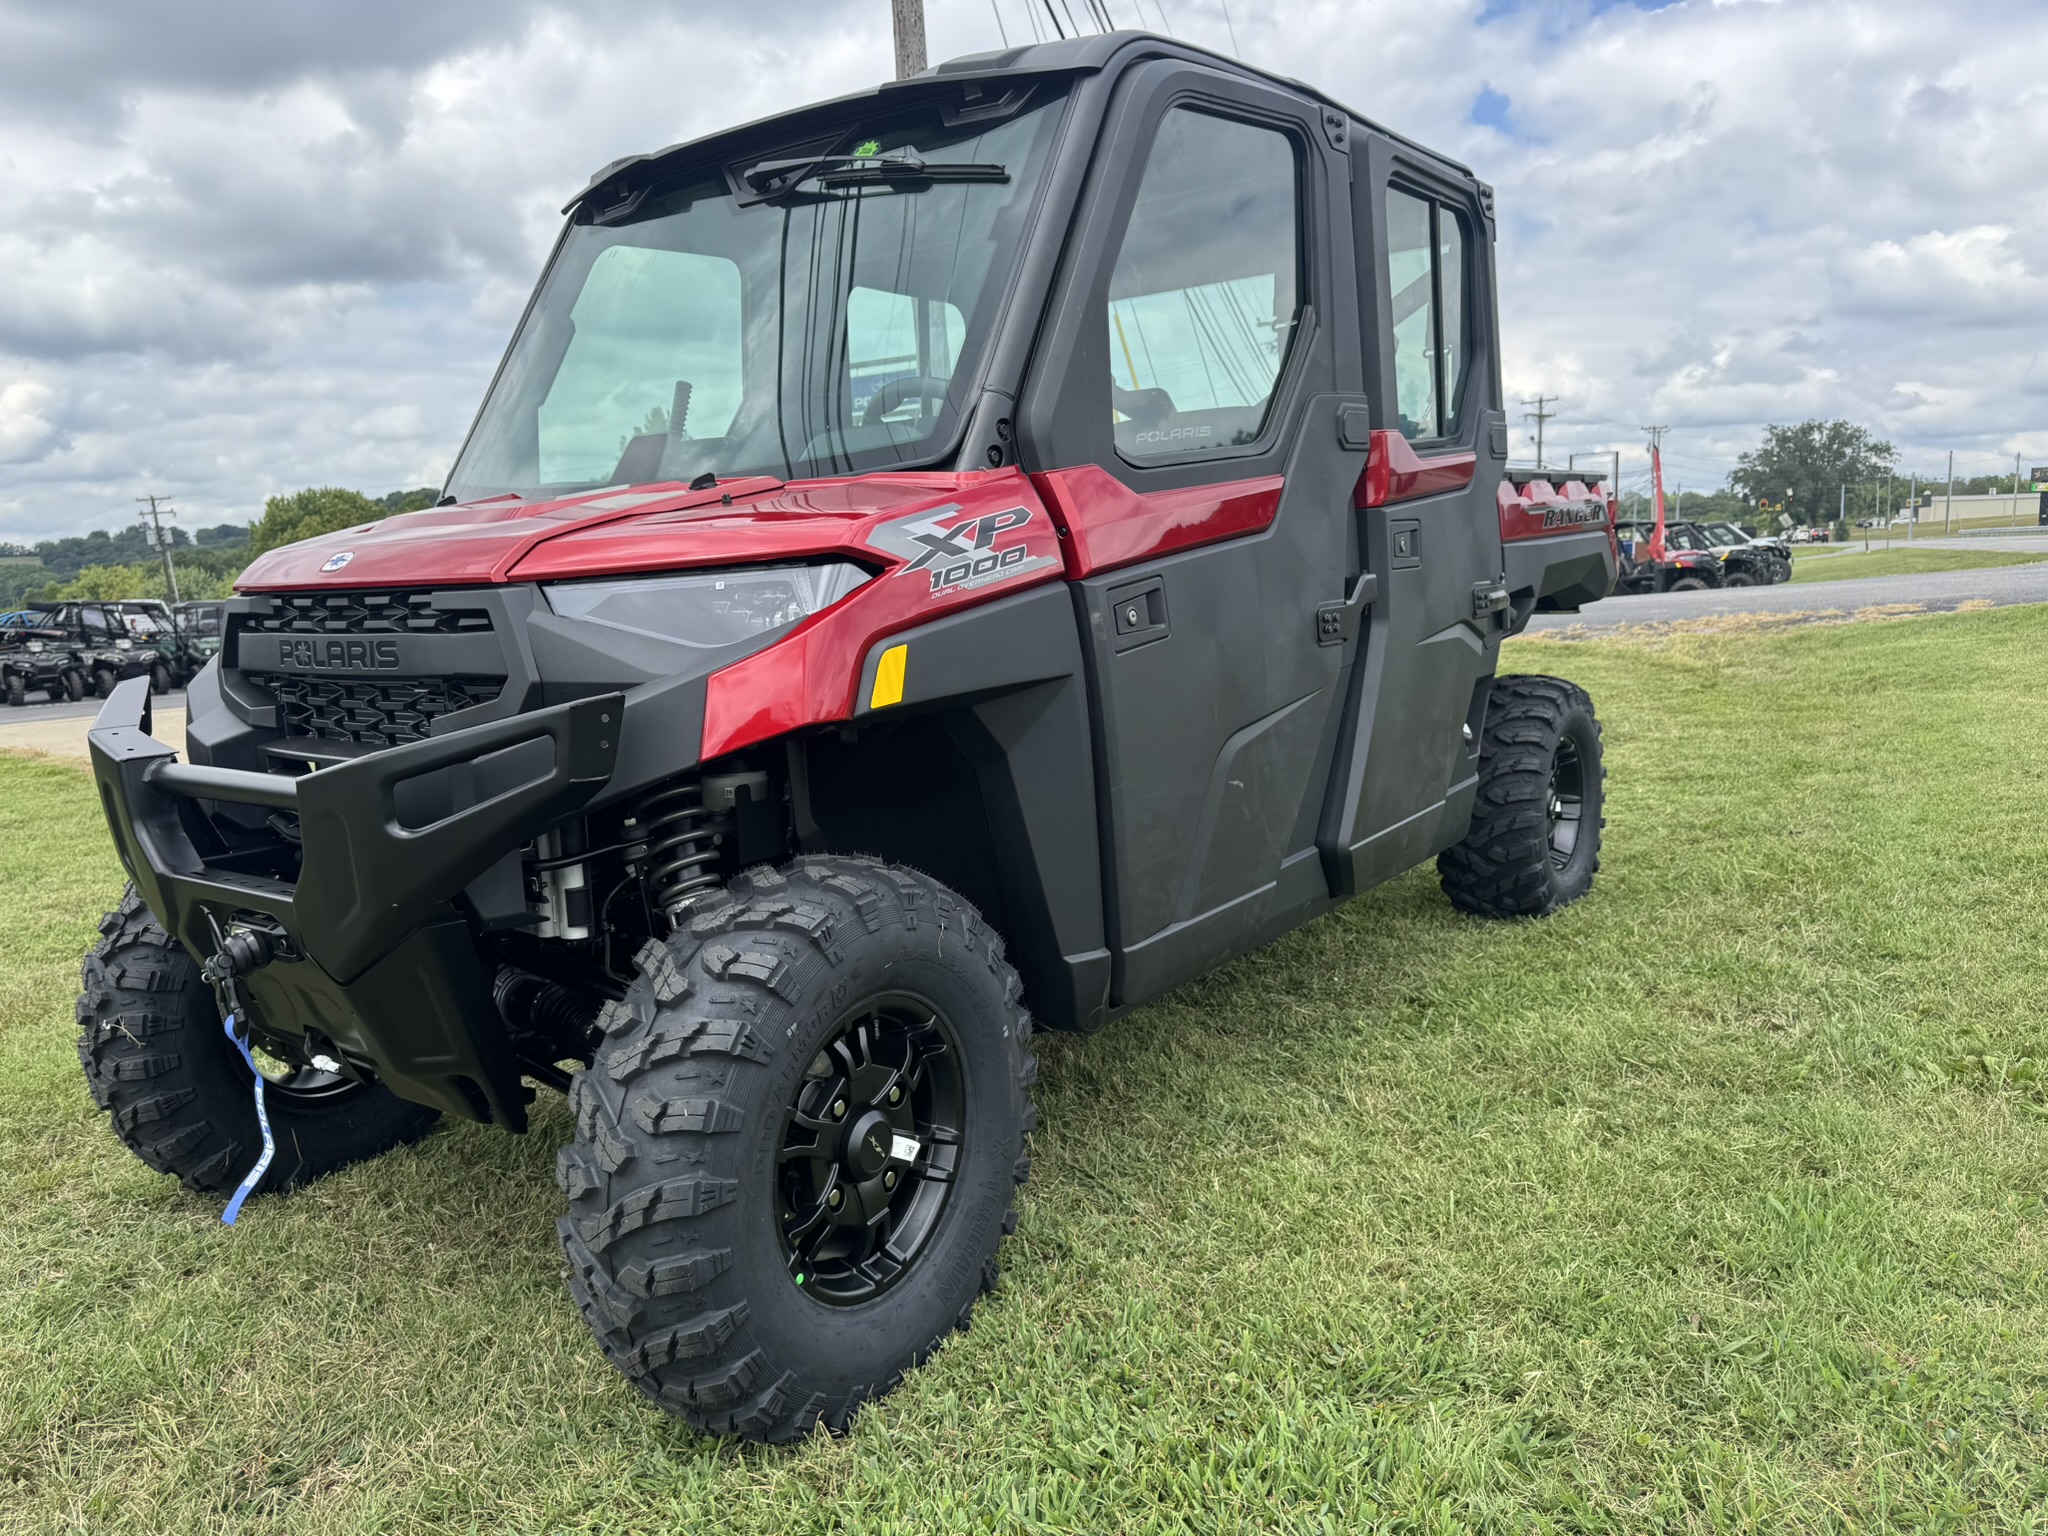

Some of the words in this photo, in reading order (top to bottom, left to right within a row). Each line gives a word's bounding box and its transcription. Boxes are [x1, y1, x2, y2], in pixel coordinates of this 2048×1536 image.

[1136, 426, 1211, 444] POLARIS
[1543, 504, 1602, 528] RANGER
[894, 506, 1033, 577] XP
[929, 544, 1027, 593] 1000
[931, 587, 956, 599] DUAL
[957, 571, 1004, 591] OVERHEAD
[1005, 565, 1025, 575] CAM
[278, 639, 400, 670] POLARIS
[755, 1108, 777, 1175] PRO
[774, 1000, 830, 1104] ARMOR
[244, 1086, 274, 1188] POLARIS
[867, 1135, 887, 1159] XP
[992, 1135, 1011, 1160] X
[936, 1173, 1004, 1308] TERRAIN
